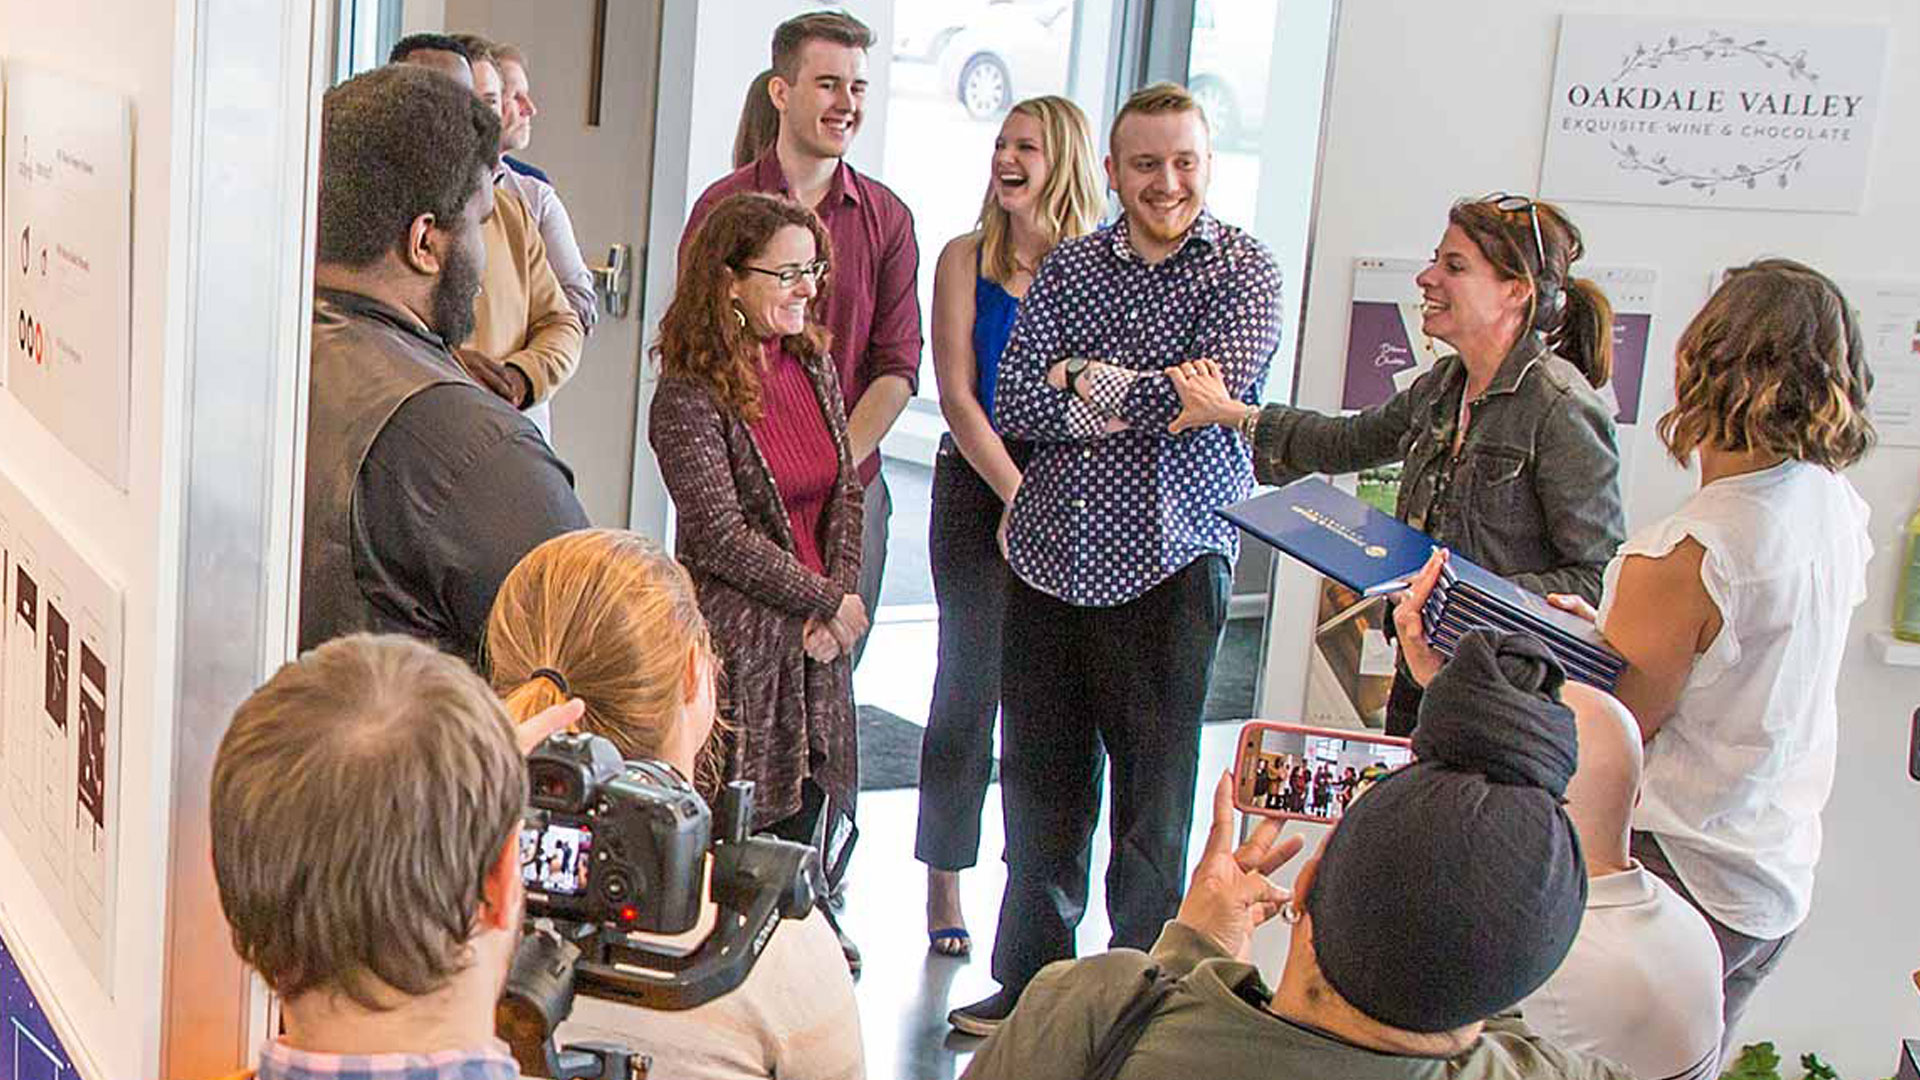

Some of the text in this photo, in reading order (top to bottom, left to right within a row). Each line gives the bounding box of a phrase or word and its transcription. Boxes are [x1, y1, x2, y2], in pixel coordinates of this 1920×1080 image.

[1568, 84, 1863, 117] OAKDALE VALLEY
[1562, 117, 1852, 141] EXQUISITE WINE & CHOCOLATE
